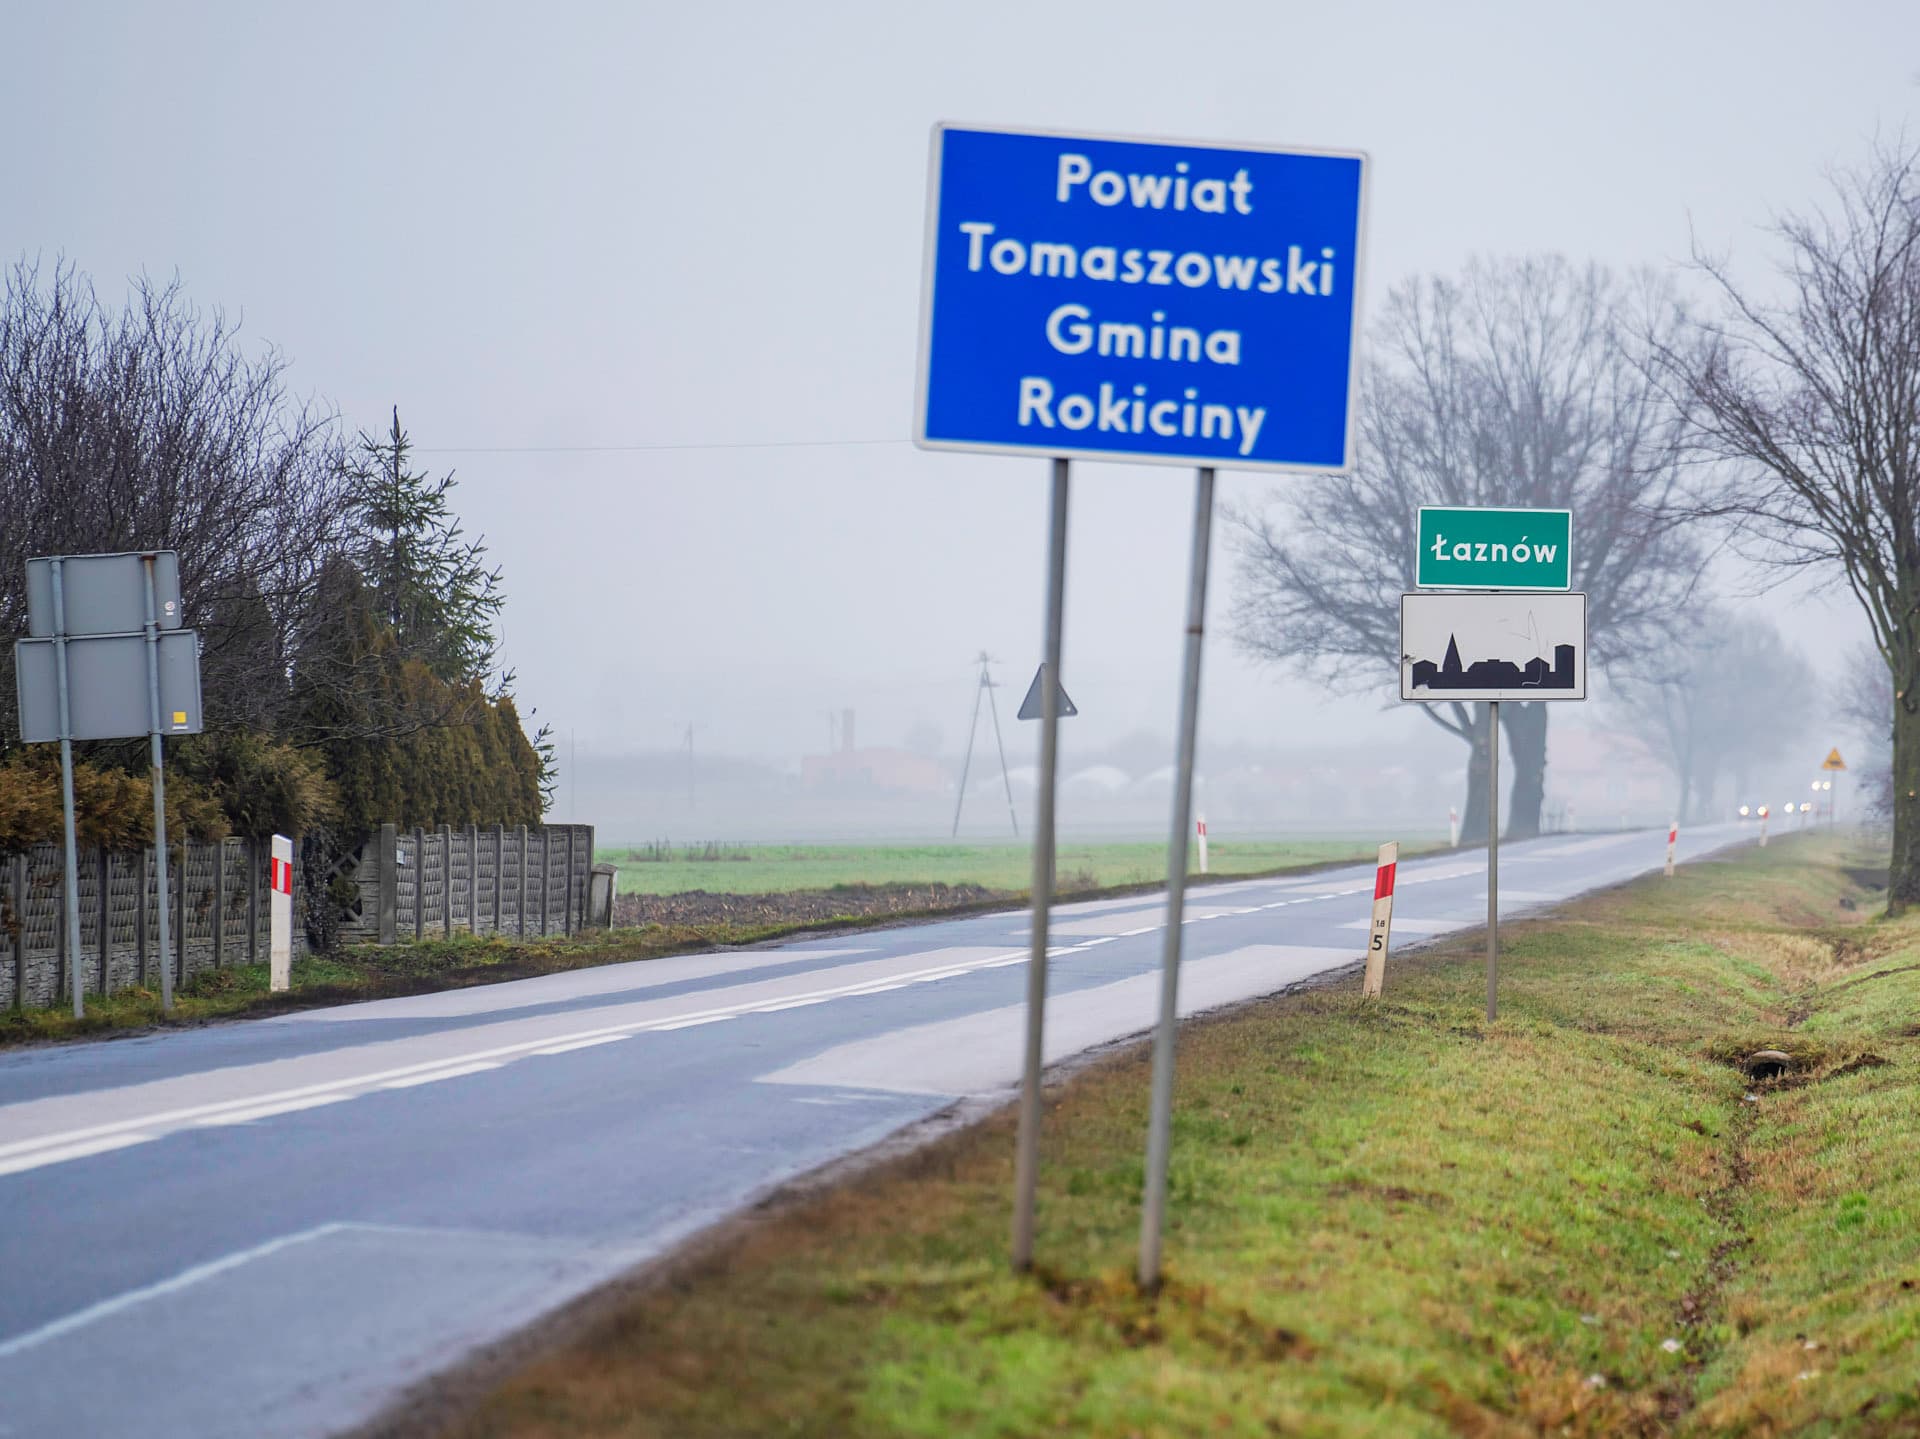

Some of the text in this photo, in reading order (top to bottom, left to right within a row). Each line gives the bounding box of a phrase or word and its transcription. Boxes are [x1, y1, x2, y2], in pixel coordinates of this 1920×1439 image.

[1057, 154, 1252, 214] Powiat
[959, 222, 1334, 296] Tomaszowski
[1046, 304, 1240, 365] Gmina
[1019, 377, 1265, 455] Rokiciny
[1430, 533, 1557, 563] Łaznów
[1371, 934, 1383, 951] 5
